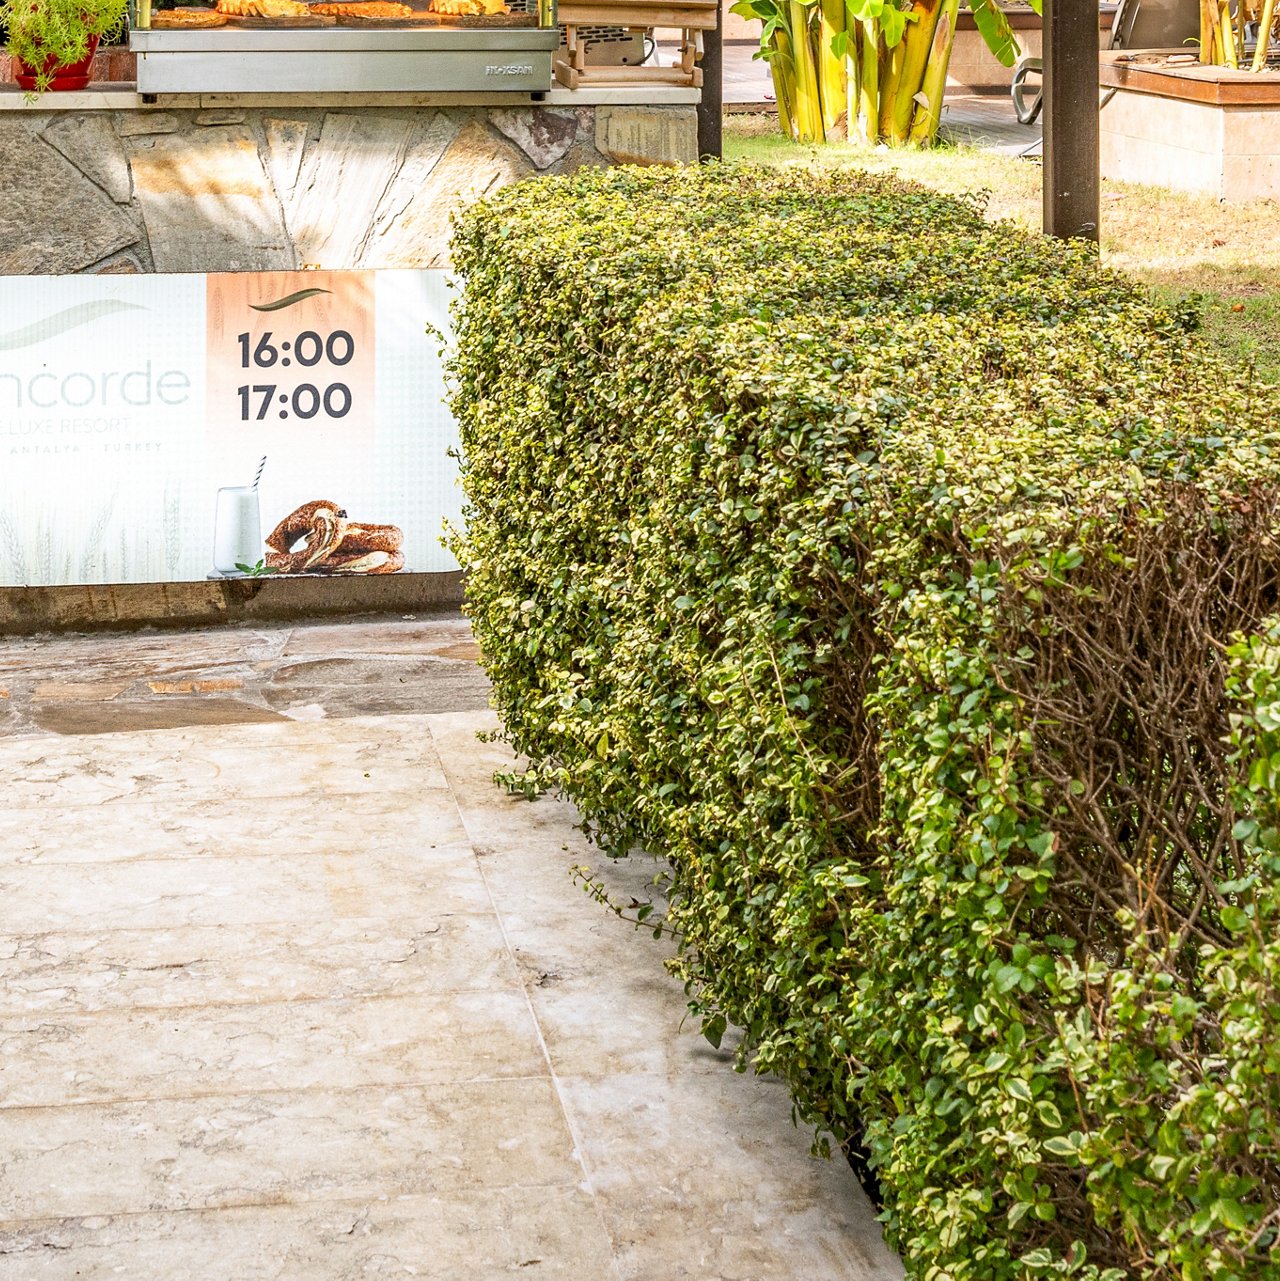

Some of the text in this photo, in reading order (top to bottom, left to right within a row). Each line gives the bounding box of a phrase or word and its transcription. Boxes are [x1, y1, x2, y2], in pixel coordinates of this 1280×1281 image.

[237, 329, 355, 369] 16:00
[236, 382, 353, 421] 17:00
[59, 416, 132, 434] RESORT
[9, 444, 81, 455] ANTALYA
[103, 442, 163, 453] TURKEY
